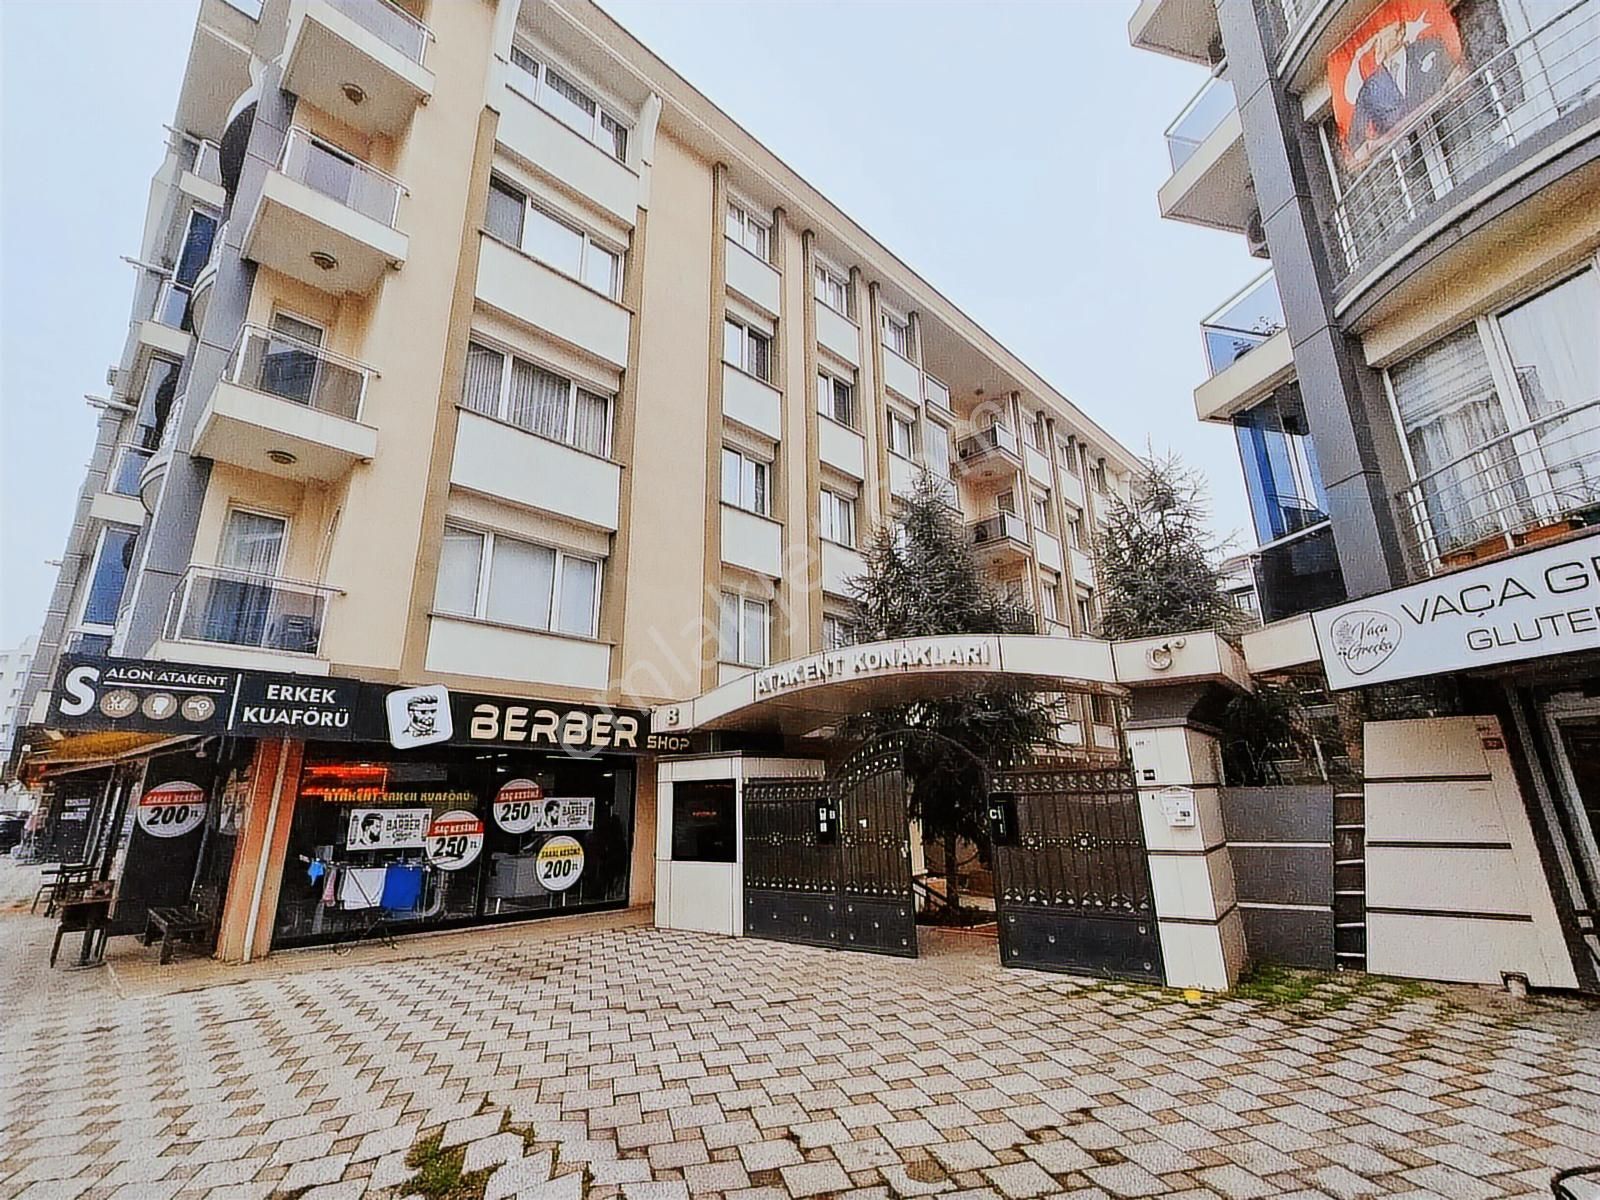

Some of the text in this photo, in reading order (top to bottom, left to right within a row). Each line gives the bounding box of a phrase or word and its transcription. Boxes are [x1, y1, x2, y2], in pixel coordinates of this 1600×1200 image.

[1400, 556, 1600, 624] VAÇA G
[157, 671, 228, 686] ATAKENT
[758, 656, 845, 695] ATAKENT
[267, 684, 336, 703] ERKEK
[243, 706, 349, 727] KUAFÖRÜ
[470, 703, 691, 751] BERBER SHOP
[147, 806, 190, 825] 200
[500, 802, 531, 821] 250
[386, 819, 420, 831] BARBER
[433, 836, 468, 858] 250
[543, 859, 572, 879] 200
